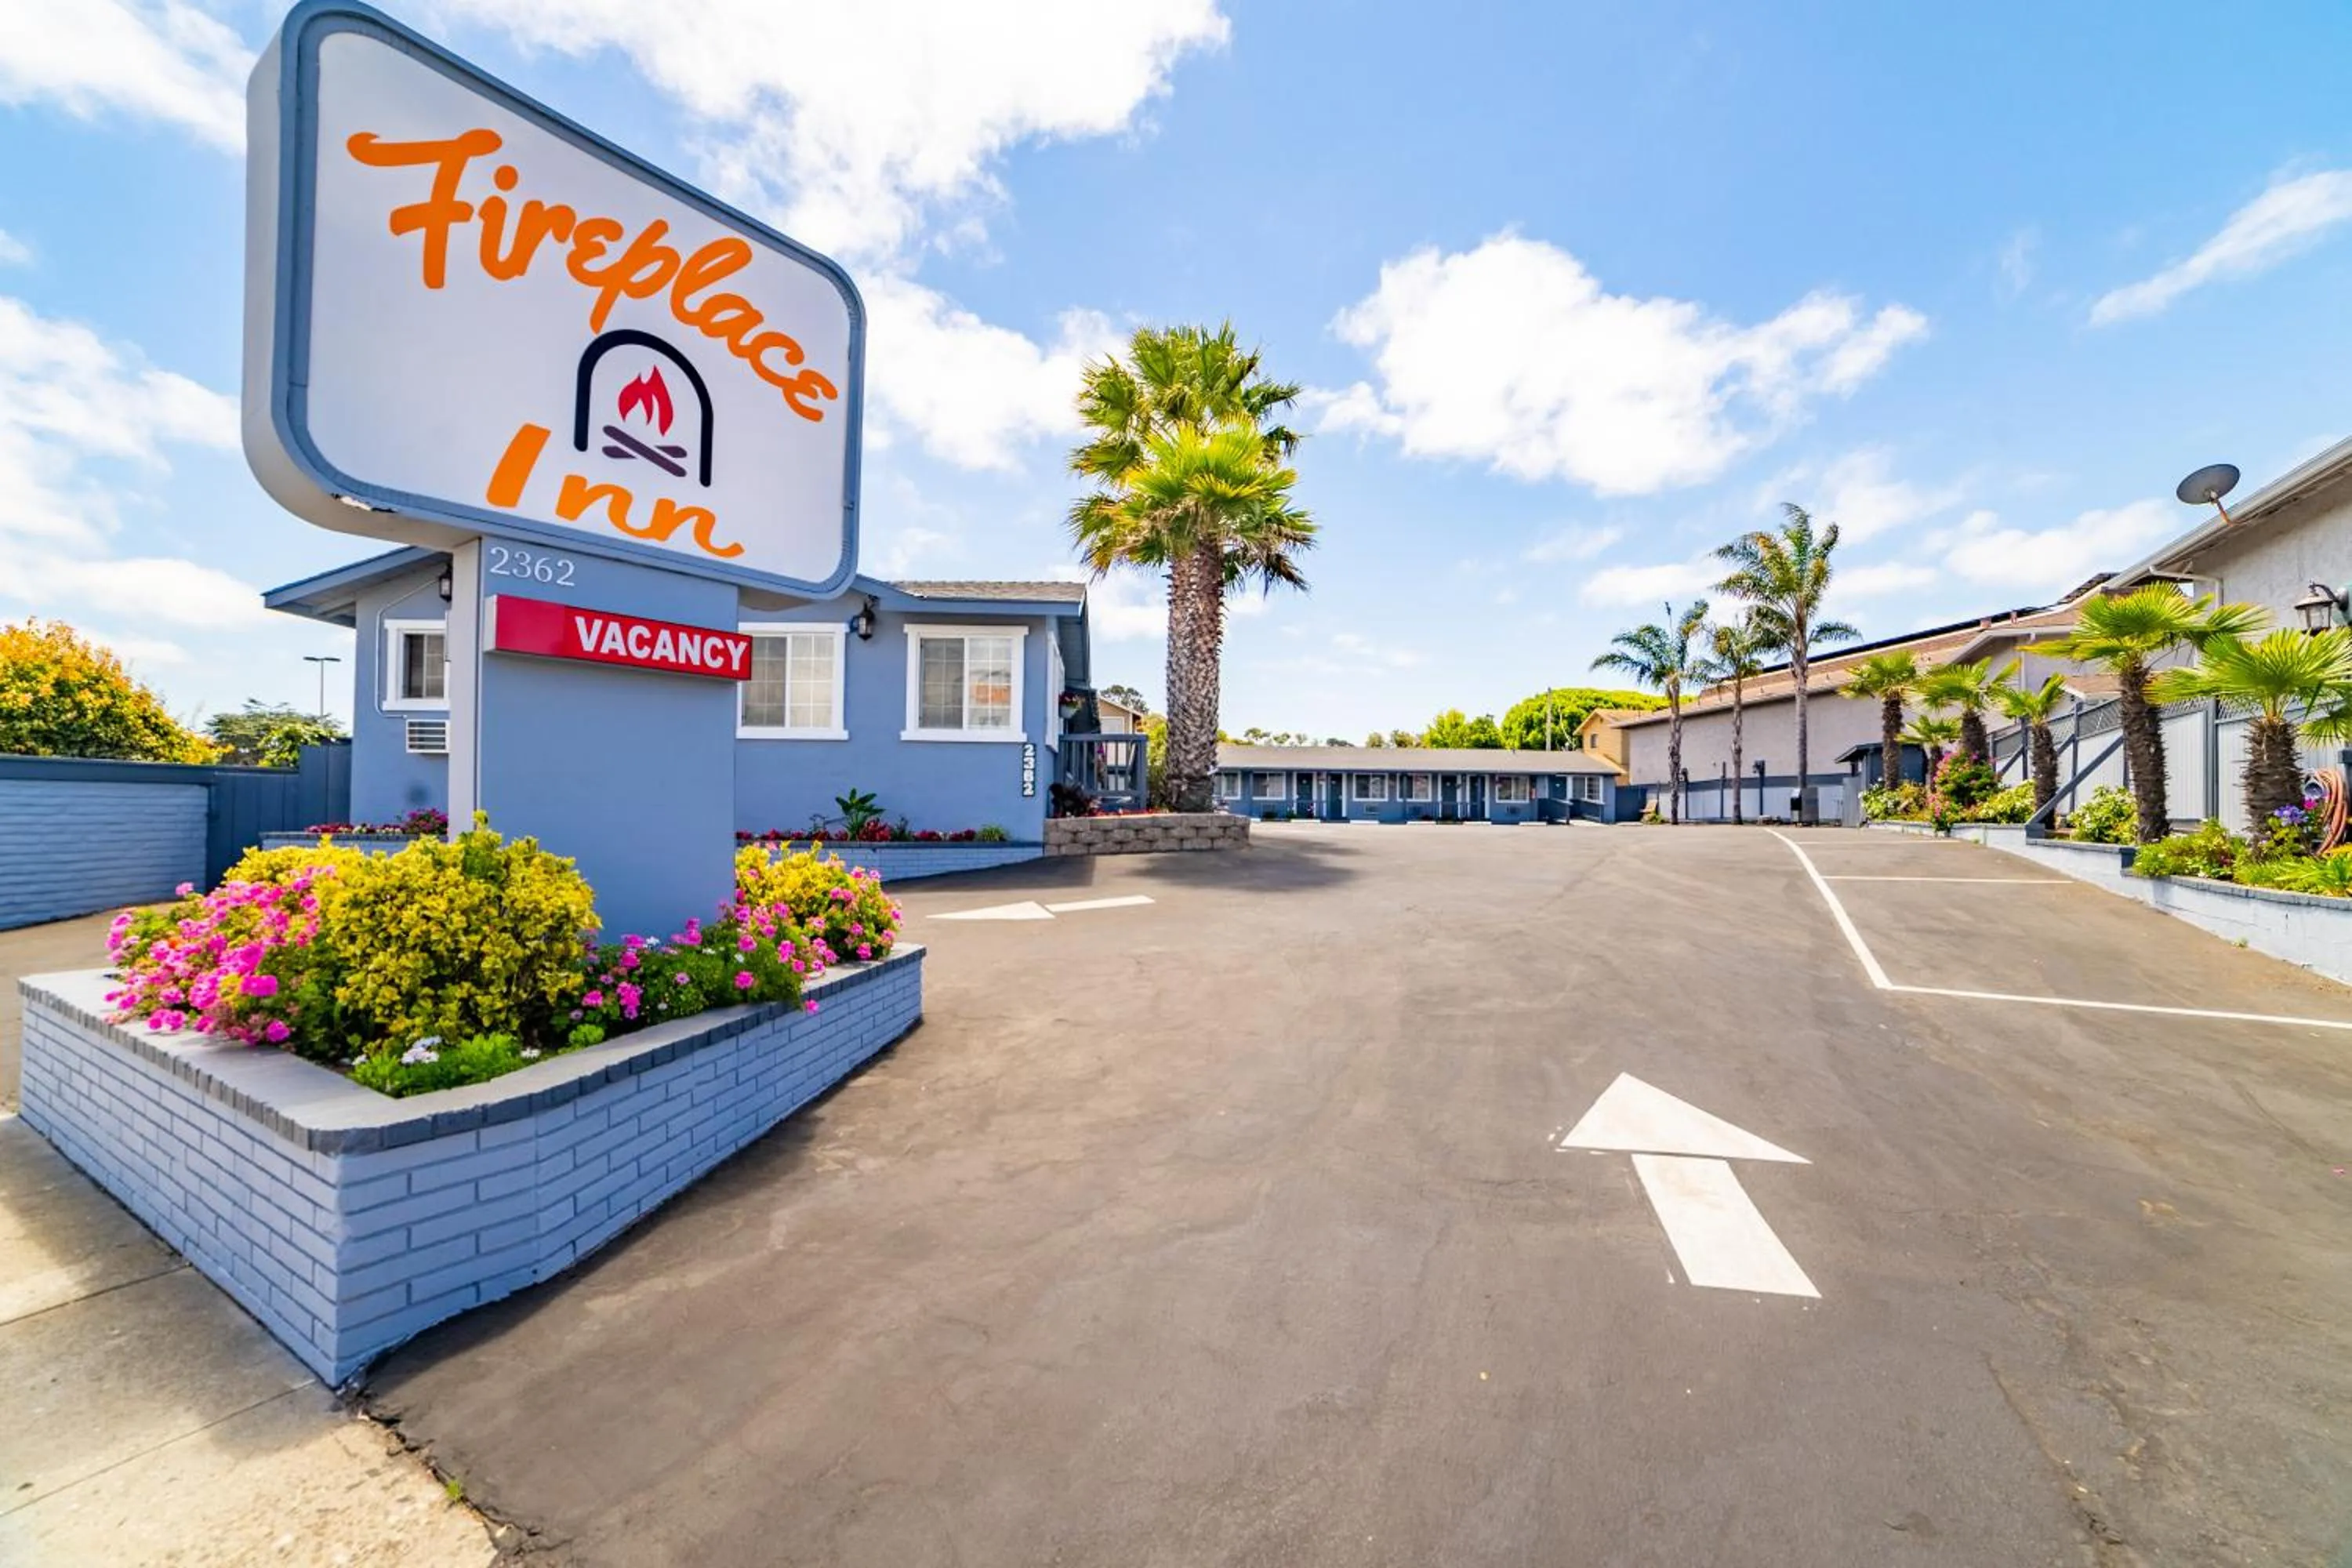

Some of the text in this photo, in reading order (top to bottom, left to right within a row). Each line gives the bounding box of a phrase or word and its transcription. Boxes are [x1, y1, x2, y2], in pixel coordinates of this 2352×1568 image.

[347, 129, 837, 423] Fireplace
[486, 423, 744, 558] Inn
[490, 546, 575, 586] 2362
[575, 615, 748, 670] VACANCY
